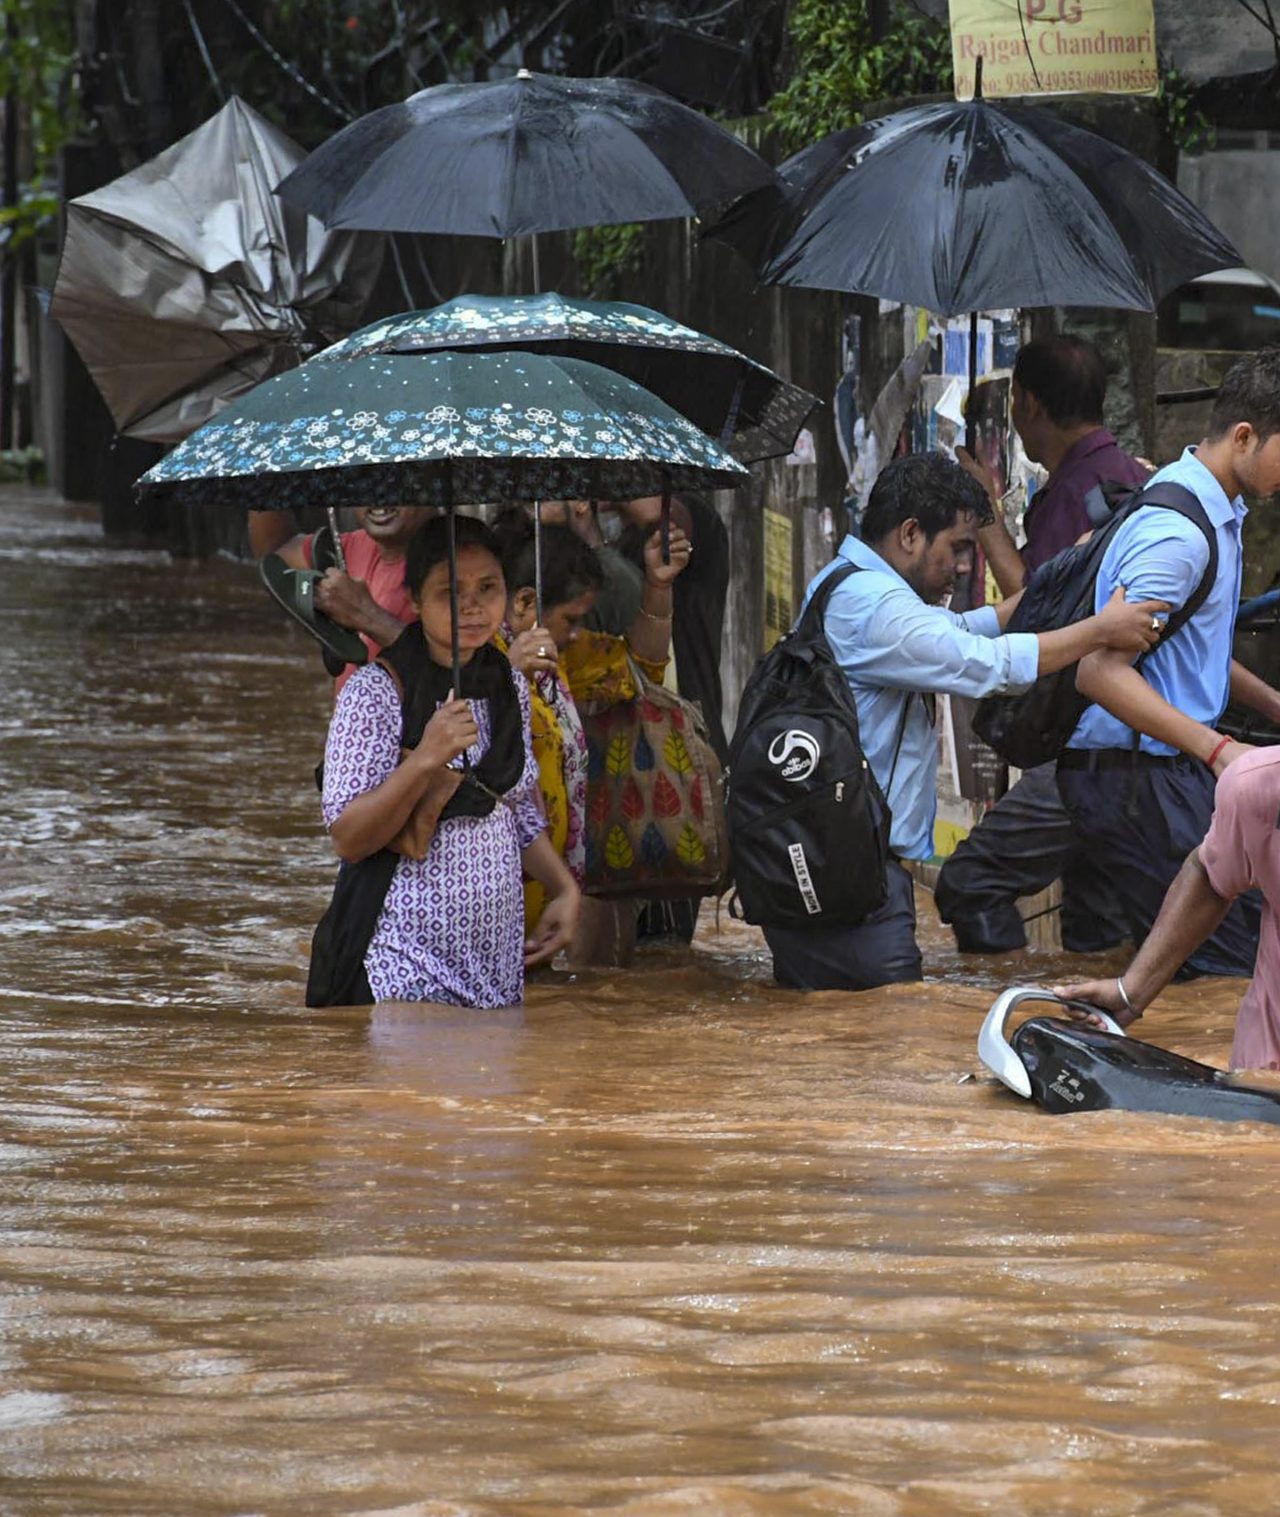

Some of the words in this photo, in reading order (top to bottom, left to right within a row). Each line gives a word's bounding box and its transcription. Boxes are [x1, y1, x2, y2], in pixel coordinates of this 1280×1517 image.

[960, 33, 1031, 65] Rajgar
[1039, 29, 1152, 57] Chandmari
[791, 845, 807, 876] STYLE
[800, 877, 810, 888] IN
[804, 889, 819, 913] MOVE
